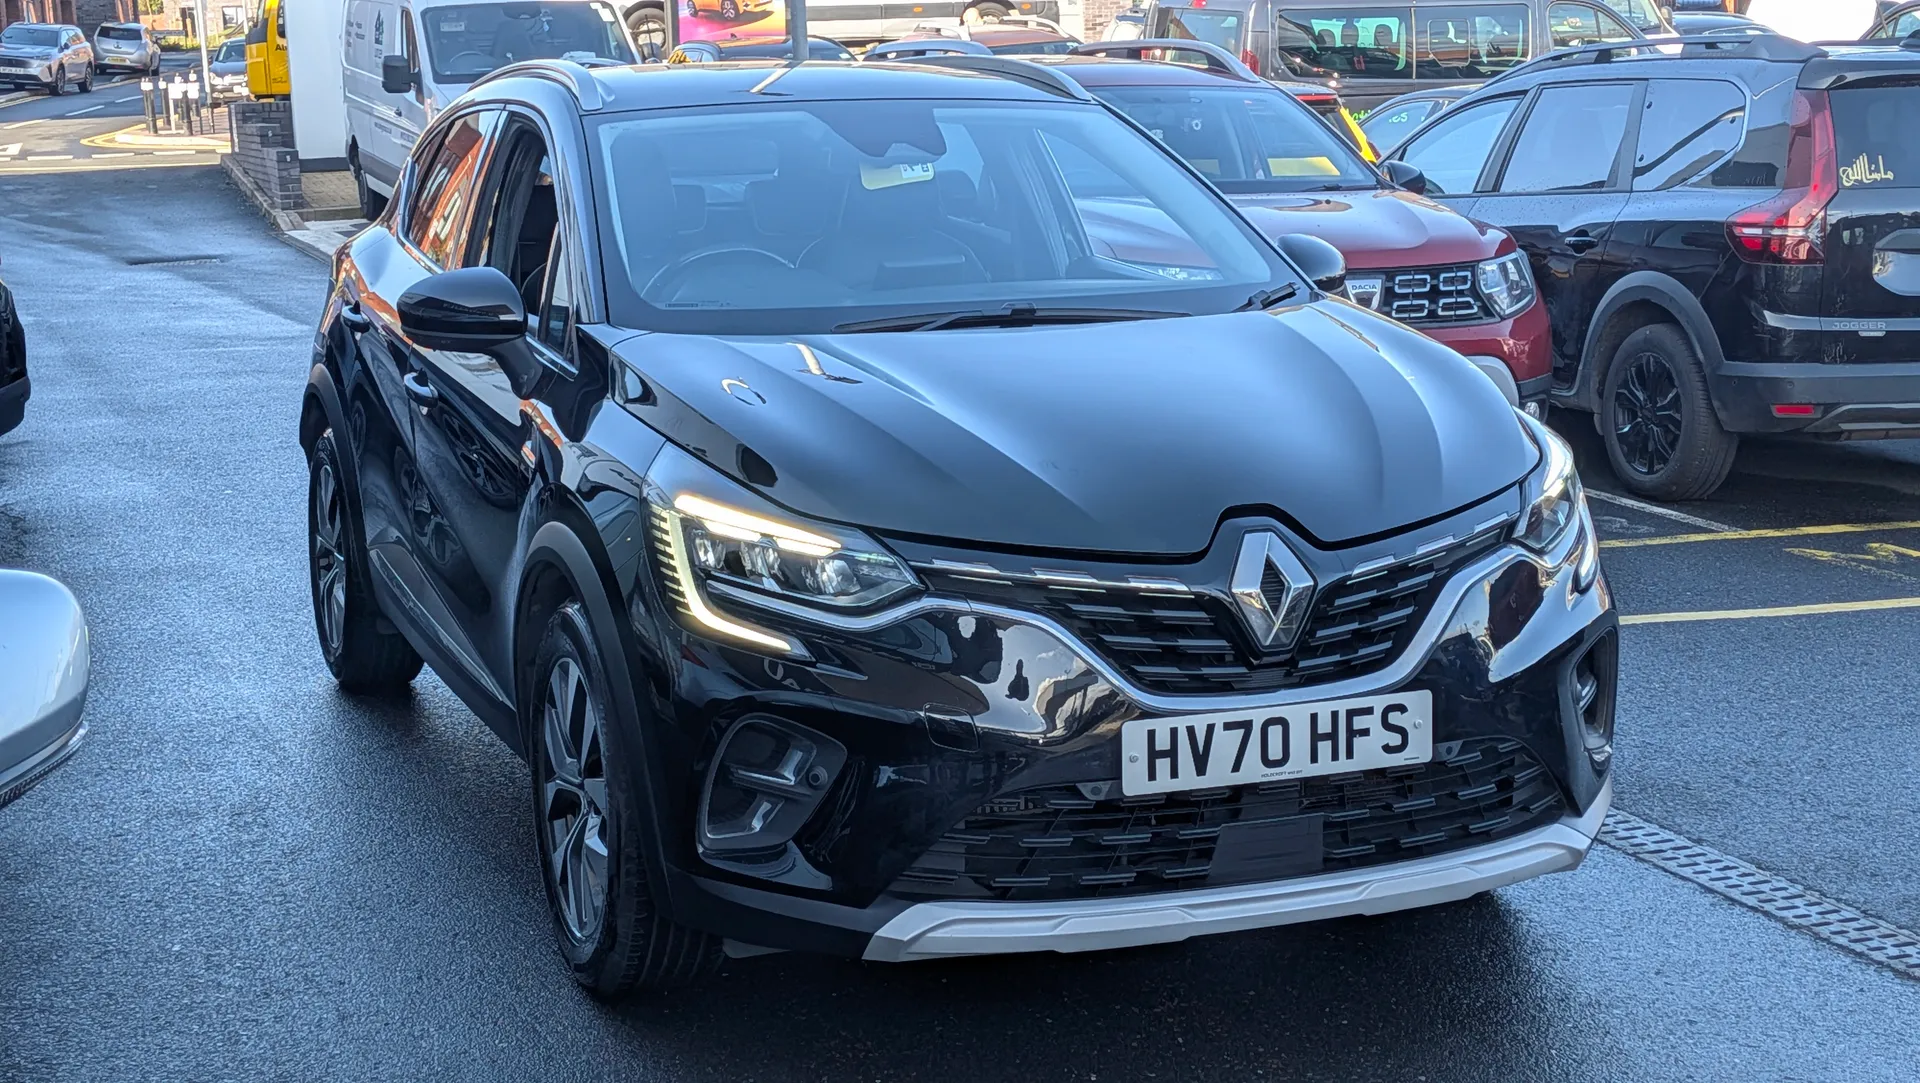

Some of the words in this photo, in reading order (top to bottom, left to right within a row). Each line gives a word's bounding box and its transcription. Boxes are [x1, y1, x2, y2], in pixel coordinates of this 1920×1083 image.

[1832, 321, 1886, 329] JOGGER
[1147, 716, 1291, 782] HV70
[1309, 703, 1410, 765] HFS
